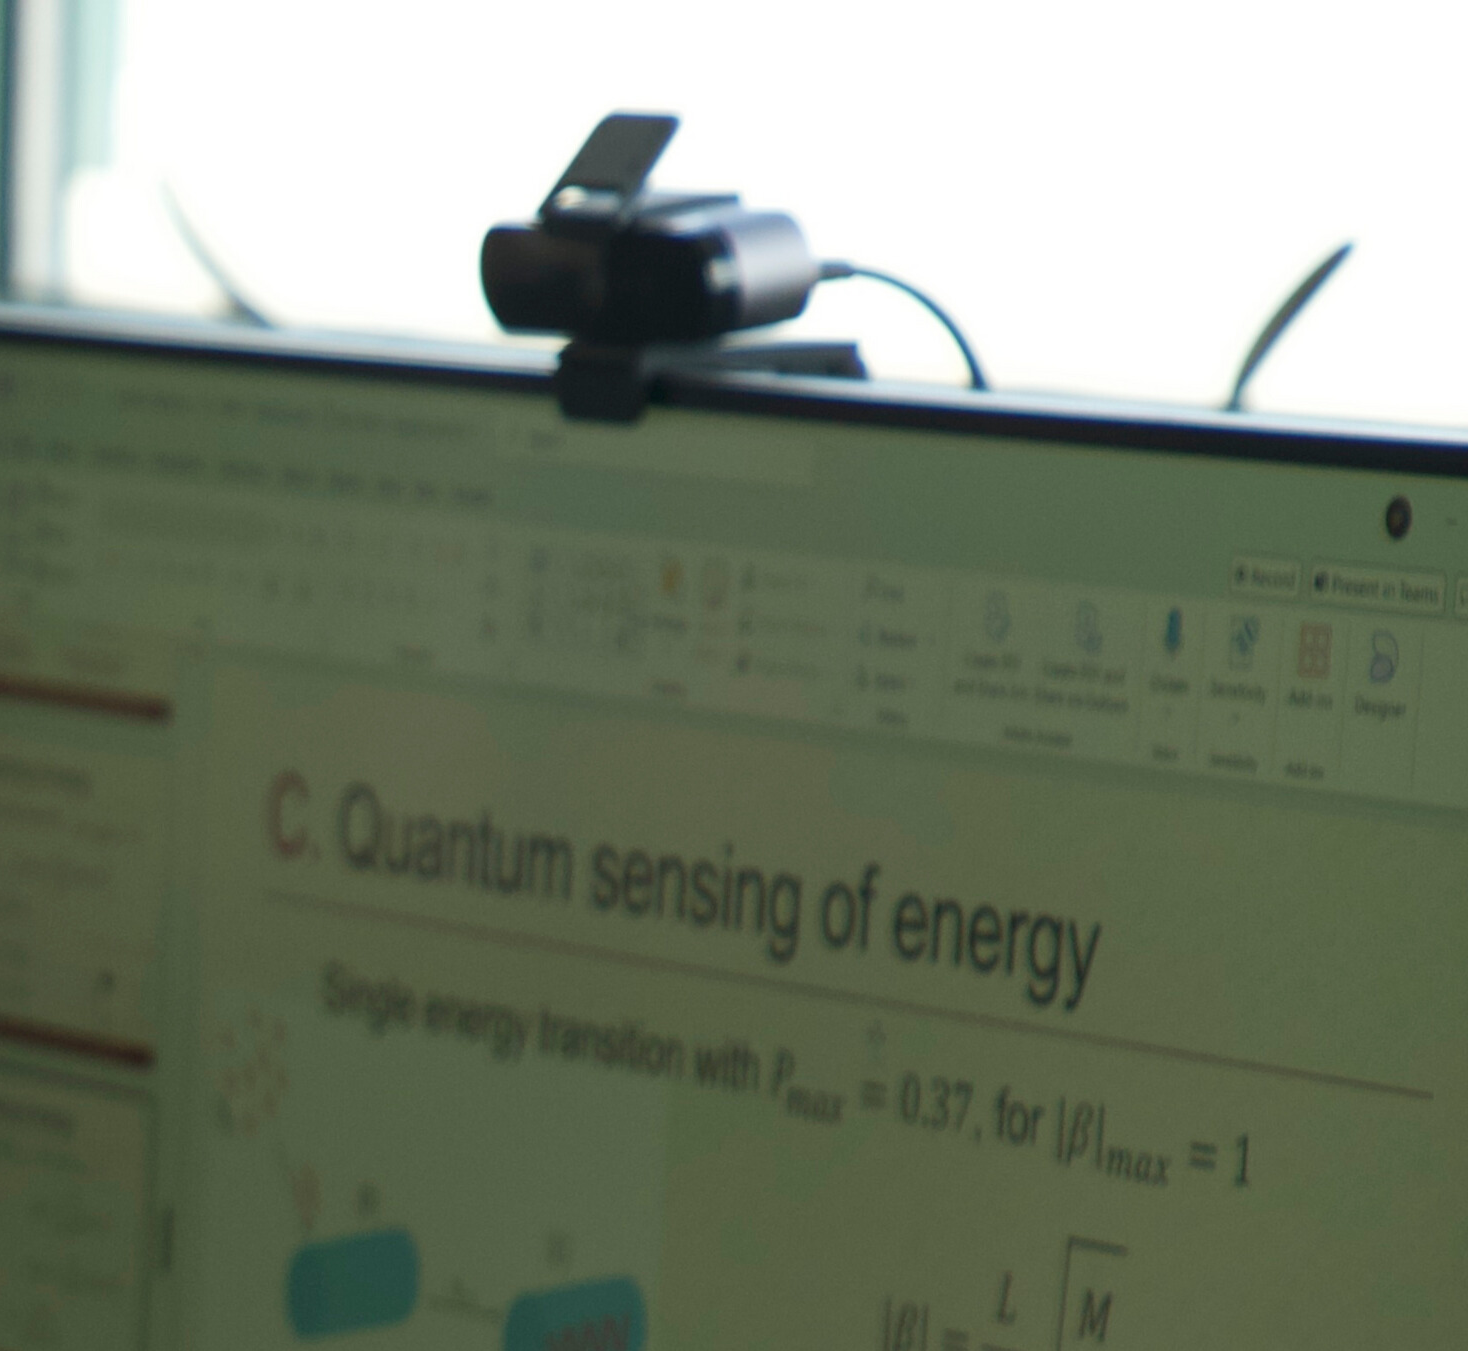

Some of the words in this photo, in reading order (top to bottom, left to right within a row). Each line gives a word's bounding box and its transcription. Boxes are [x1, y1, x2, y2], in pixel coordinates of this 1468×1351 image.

[336, 782, 574, 902] Quantum
[591, 842, 801, 964] sensing
[820, 863, 881, 953] of
[892, 888, 1102, 1012] energy
[424, 991, 527, 1064] energy
[538, 1004, 686, 1080] transition
[695, 1034, 761, 1093] with
[993, 1084, 1044, 1147] for
